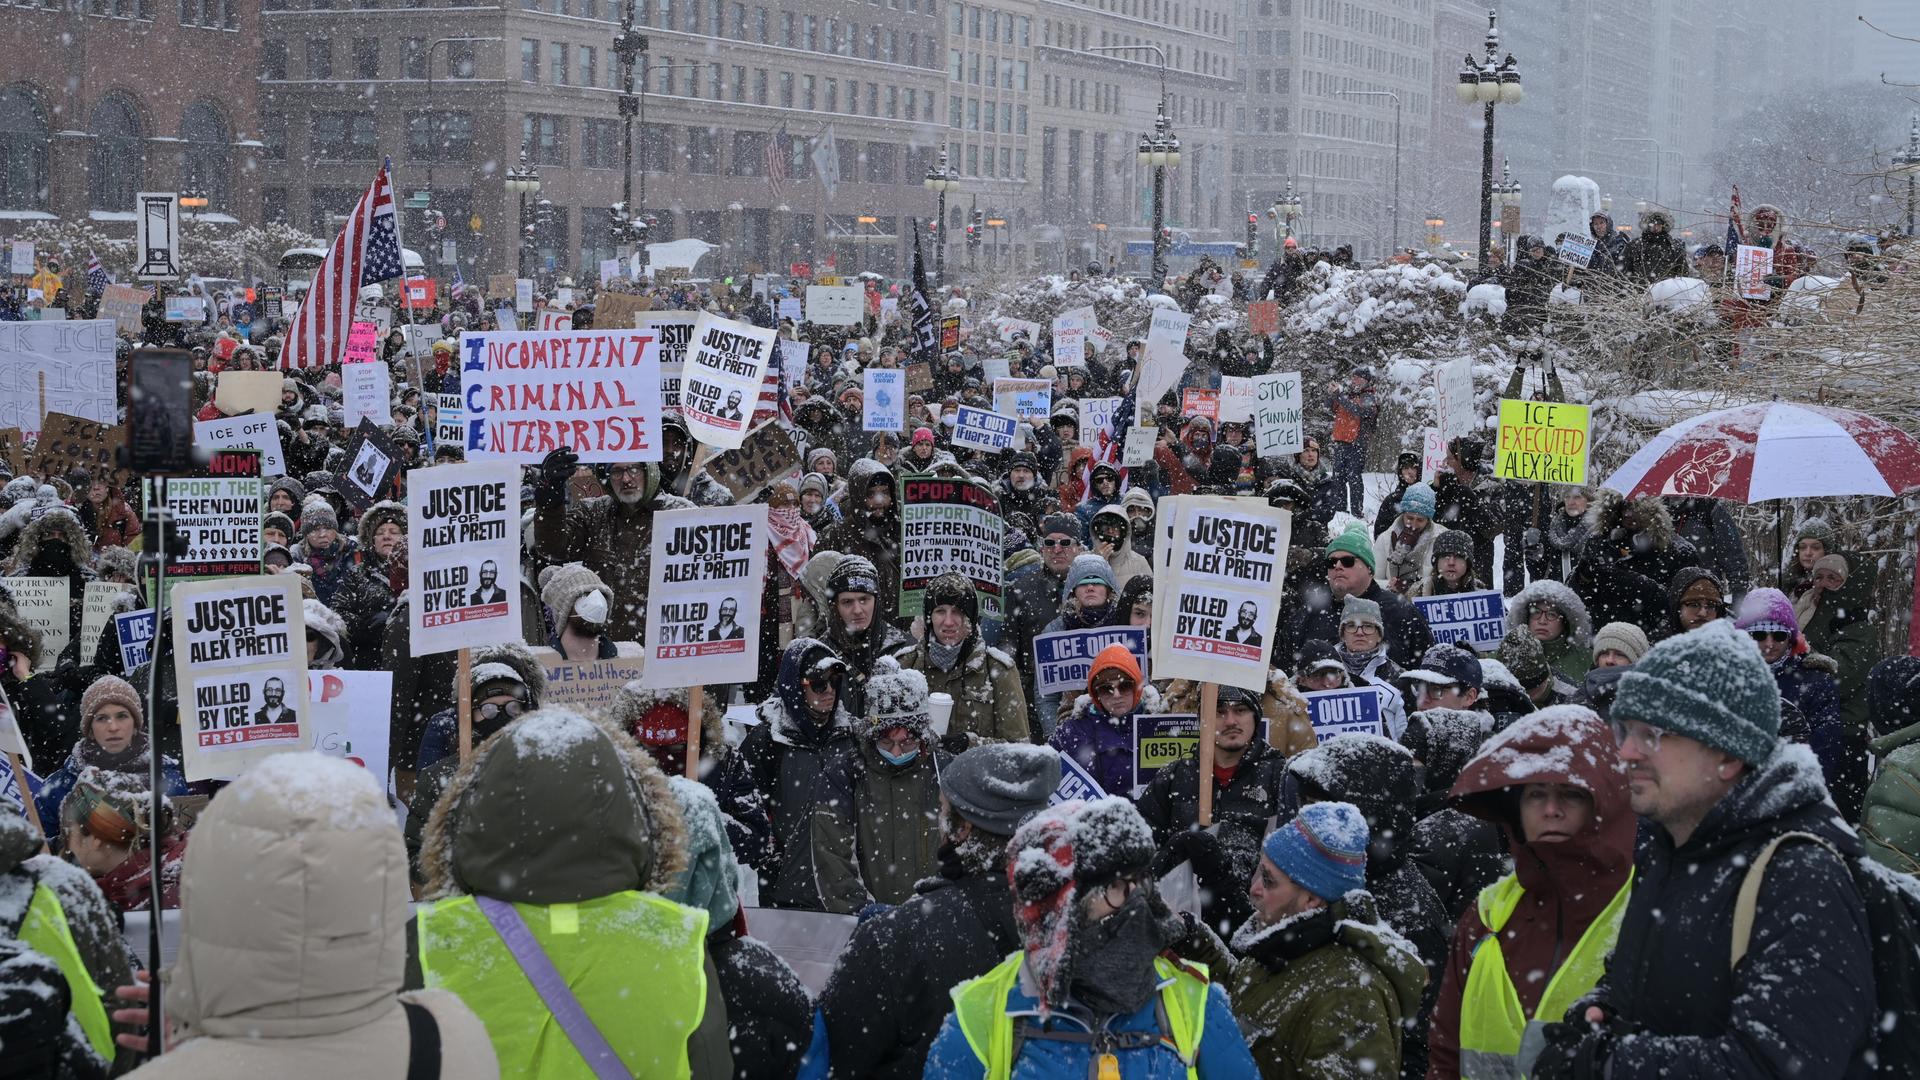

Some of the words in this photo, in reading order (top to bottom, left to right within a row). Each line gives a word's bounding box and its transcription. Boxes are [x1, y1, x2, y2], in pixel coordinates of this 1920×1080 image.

[361, 307, 376, 319] CE
[1062, 319, 1074, 329] NO
[1053, 328, 1084, 337] FUNDING
[1153, 319, 1187, 331] ABOLISH
[55, 322, 112, 352] ICE
[702, 328, 763, 360] JUSTICE
[464, 336, 654, 372] INCOMPETENT
[660, 350, 672, 362] EX
[718, 350, 740, 361] FOR
[1056, 346, 1080, 355] ICE
[55, 360, 112, 392] ICE
[696, 350, 722, 370] ALEX
[723, 359, 757, 379] PRETTI
[466, 380, 636, 414] CRIMINAL
[665, 393, 682, 406] ICE
[688, 379, 721, 400] KILLED
[1223, 380, 1254, 398] Abolis
[1258, 380, 1296, 401] STOP
[686, 392, 698, 408] BY
[699, 398, 716, 415] ICE
[1026, 407, 1047, 415] TODOS
[1524, 403, 1558, 427] ICE
[209, 428, 234, 440] ICE
[243, 423, 268, 435] OFF
[965, 411, 984, 428] ICE
[984, 416, 1008, 433] OUT!
[467, 416, 650, 453] ENTERPRISE
[956, 426, 991, 445] ¡Fuera
[992, 434, 1011, 448] ICE!
[1263, 425, 1299, 450] ICE!
[1502, 425, 1584, 455] EXECUTED
[1127, 447, 1140, 455] Alex
[209, 453, 258, 474] NOW!
[1504, 451, 1540, 480] ALEX
[1543, 453, 1574, 482] Pretti
[228, 481, 258, 496] THE
[906, 483, 955, 501] CPOP
[169, 498, 258, 515] FERENDUM
[422, 482, 506, 520] JUSTICE
[228, 516, 258, 526] POWER
[449, 513, 480, 524] FOR
[905, 507, 972, 521] SUPPORT
[978, 511, 1000, 531] THE
[200, 528, 258, 545] POLICE
[422, 524, 456, 549] ALEX
[460, 519, 506, 543] PRETTI
[665, 522, 752, 556] JUSTICE
[905, 521, 1000, 546] REFERENDUM
[1189, 515, 1278, 555] JUSTICE
[693, 553, 724, 562] FOR
[905, 539, 921, 548] FOR
[977, 541, 1000, 556] POWER
[1215, 547, 1246, 558] FOR
[167, 565, 194, 574] POWER
[212, 564, 224, 573] THE
[229, 563, 259, 572] PEOPLE
[663, 563, 700, 583] ALEX
[702, 558, 750, 580] PRETTI
[905, 548, 943, 564] OVER
[951, 548, 1000, 571] POLICE
[1184, 552, 1222, 575] ALEX
[1224, 557, 1273, 582] PRETTI
[423, 566, 469, 591] KILLED
[424, 592, 441, 613] BY
[445, 588, 466, 609] ICE
[1179, 593, 1228, 618] KILLED
[1427, 602, 1451, 623] ICE
[1453, 598, 1490, 621] OUT!
[187, 594, 286, 633] JUSTICE
[661, 602, 709, 623] KILLED
[129, 616, 154, 640] ICE
[221, 627, 255, 638] FOR
[659, 625, 679, 644] BY
[682, 623, 705, 643] ICE
[1176, 615, 1198, 636] BY
[1199, 619, 1223, 640] ICE
[1474, 621, 1503, 642] ICE!
[190, 638, 231, 663] ALEX
[235, 633, 288, 657] PRETTI
[1052, 636, 1082, 661] ICE
[546, 667, 574, 681] WE
[577, 664, 603, 680] hold
[606, 663, 640, 680] these
[1043, 662, 1089, 684] ¡Fuer
[197, 682, 250, 707] KILLED
[199, 708, 219, 730] BY
[224, 706, 250, 728] ICE
[1318, 696, 1362, 726] OUT!
[1057, 771, 1090, 800] ICE
